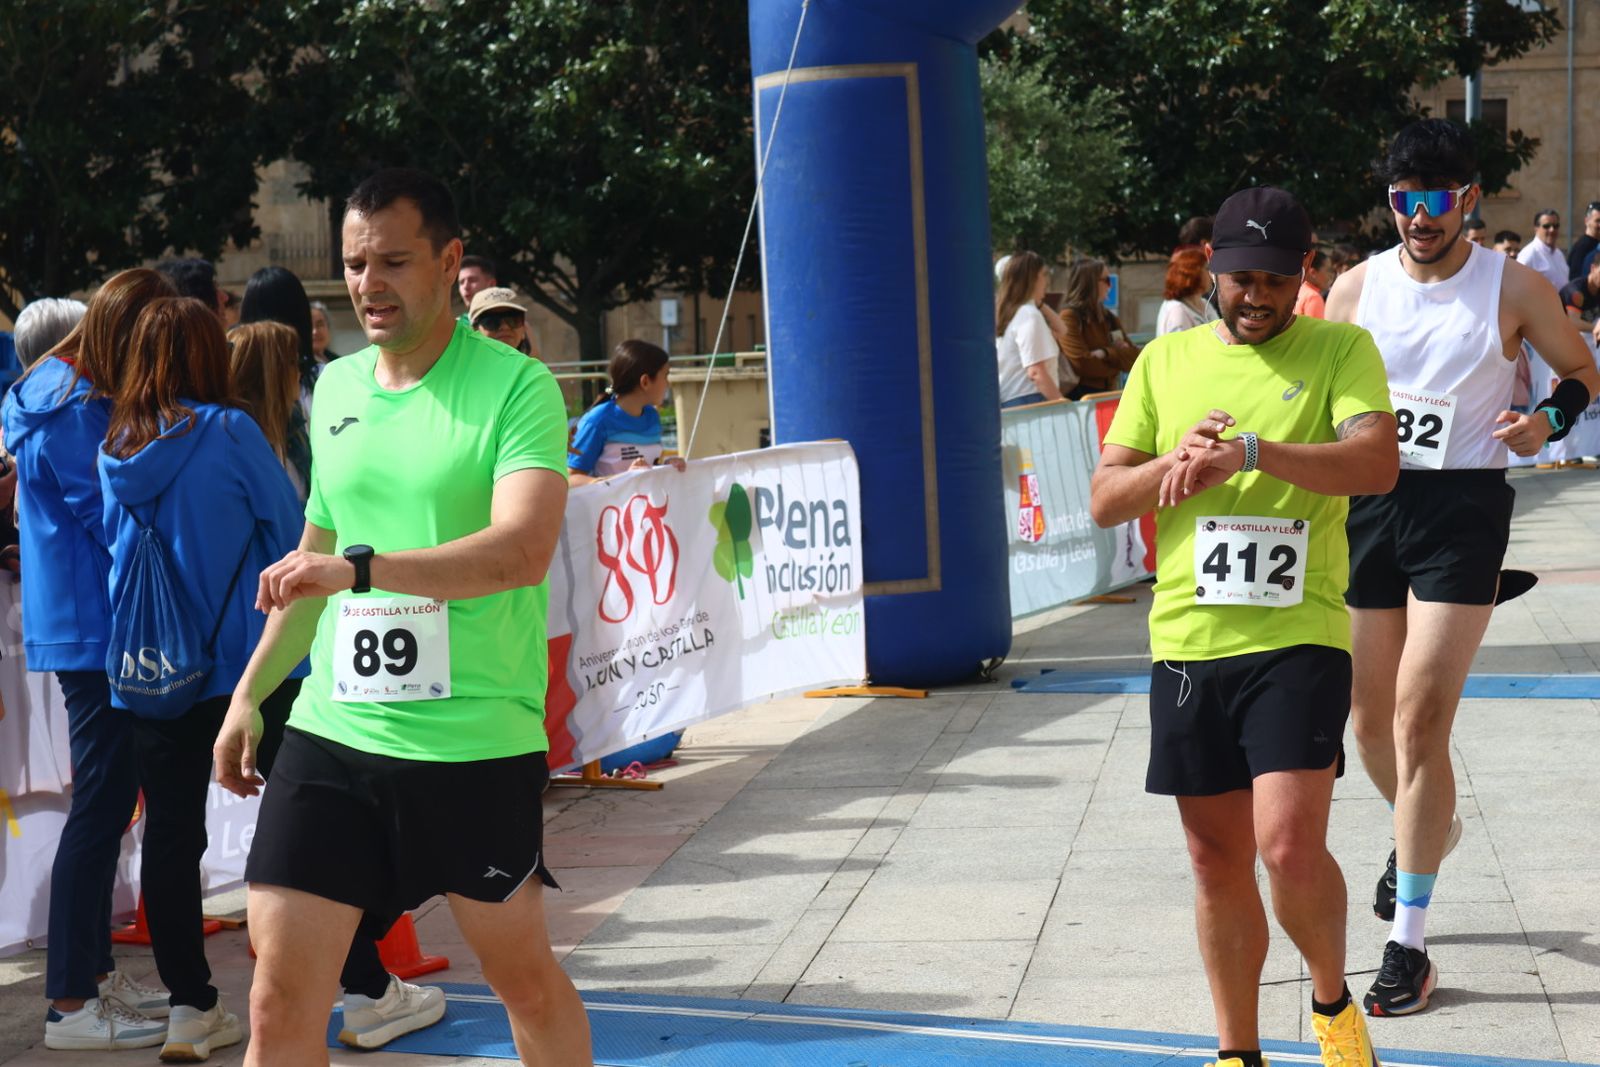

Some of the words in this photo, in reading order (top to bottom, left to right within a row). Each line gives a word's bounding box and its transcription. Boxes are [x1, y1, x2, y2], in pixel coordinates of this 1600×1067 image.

[1392, 391, 1423, 403] CASTILLA
[1430, 398, 1451, 408] LEÓN
[755, 484, 851, 549] Plena
[1230, 524, 1270, 533] CASTILLA
[1202, 542, 1298, 585] 412
[361, 606, 402, 617] CASTILLA
[403, 606, 410, 615] Y
[412, 602, 441, 615] LEÓN
[120, 647, 177, 682] DSA
[353, 628, 418, 677] 89
[623, 655, 636, 675] Y
